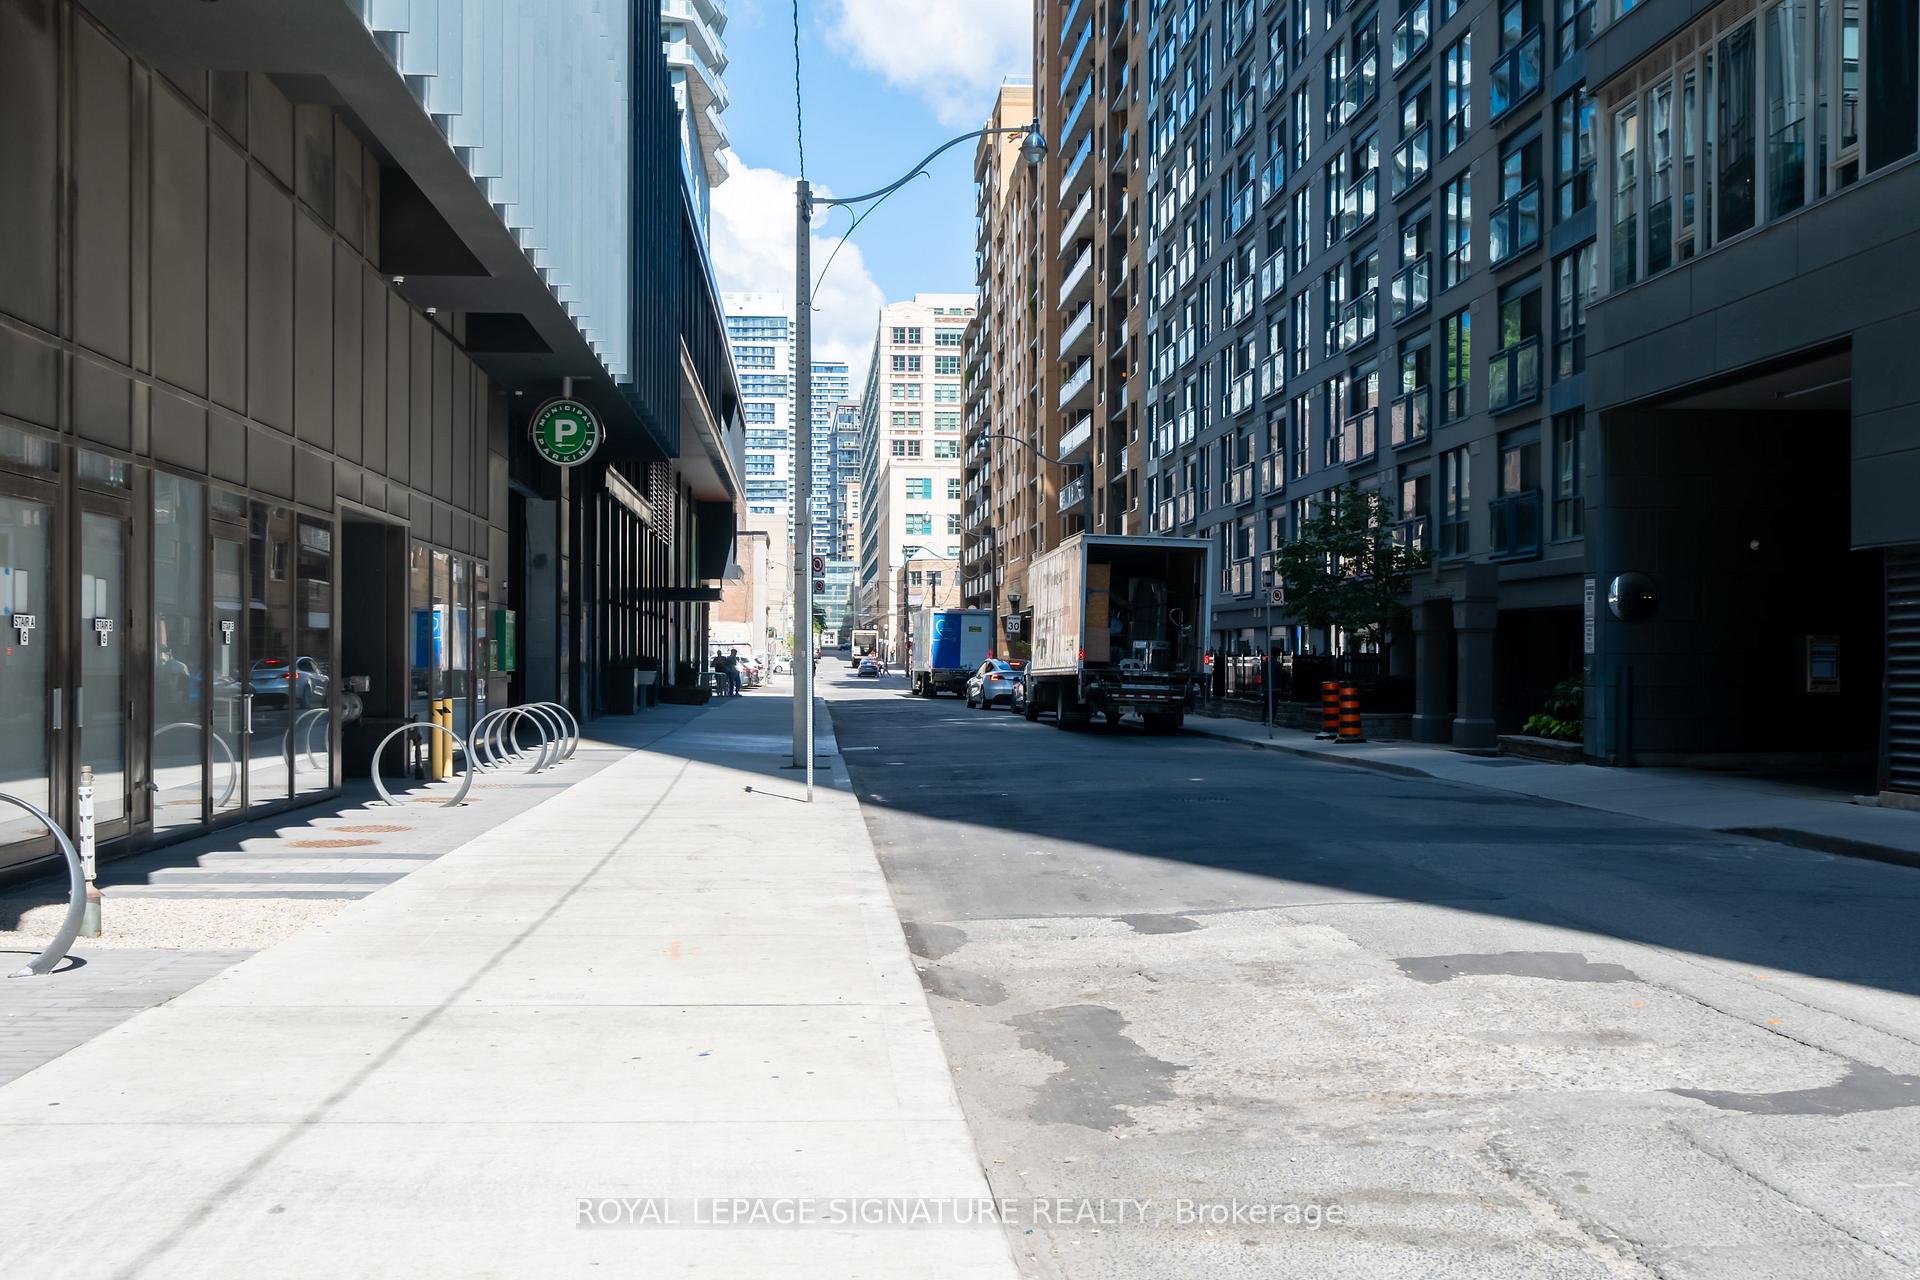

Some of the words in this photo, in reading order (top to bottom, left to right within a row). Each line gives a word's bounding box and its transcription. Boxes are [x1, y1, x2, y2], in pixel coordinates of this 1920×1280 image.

[539, 405, 592, 428] MUNICIPAL
[555, 419, 578, 443] P
[538, 438, 593, 462] PARKING
[15, 615, 30, 627] STAIR
[1008, 622, 1020, 631] 30
